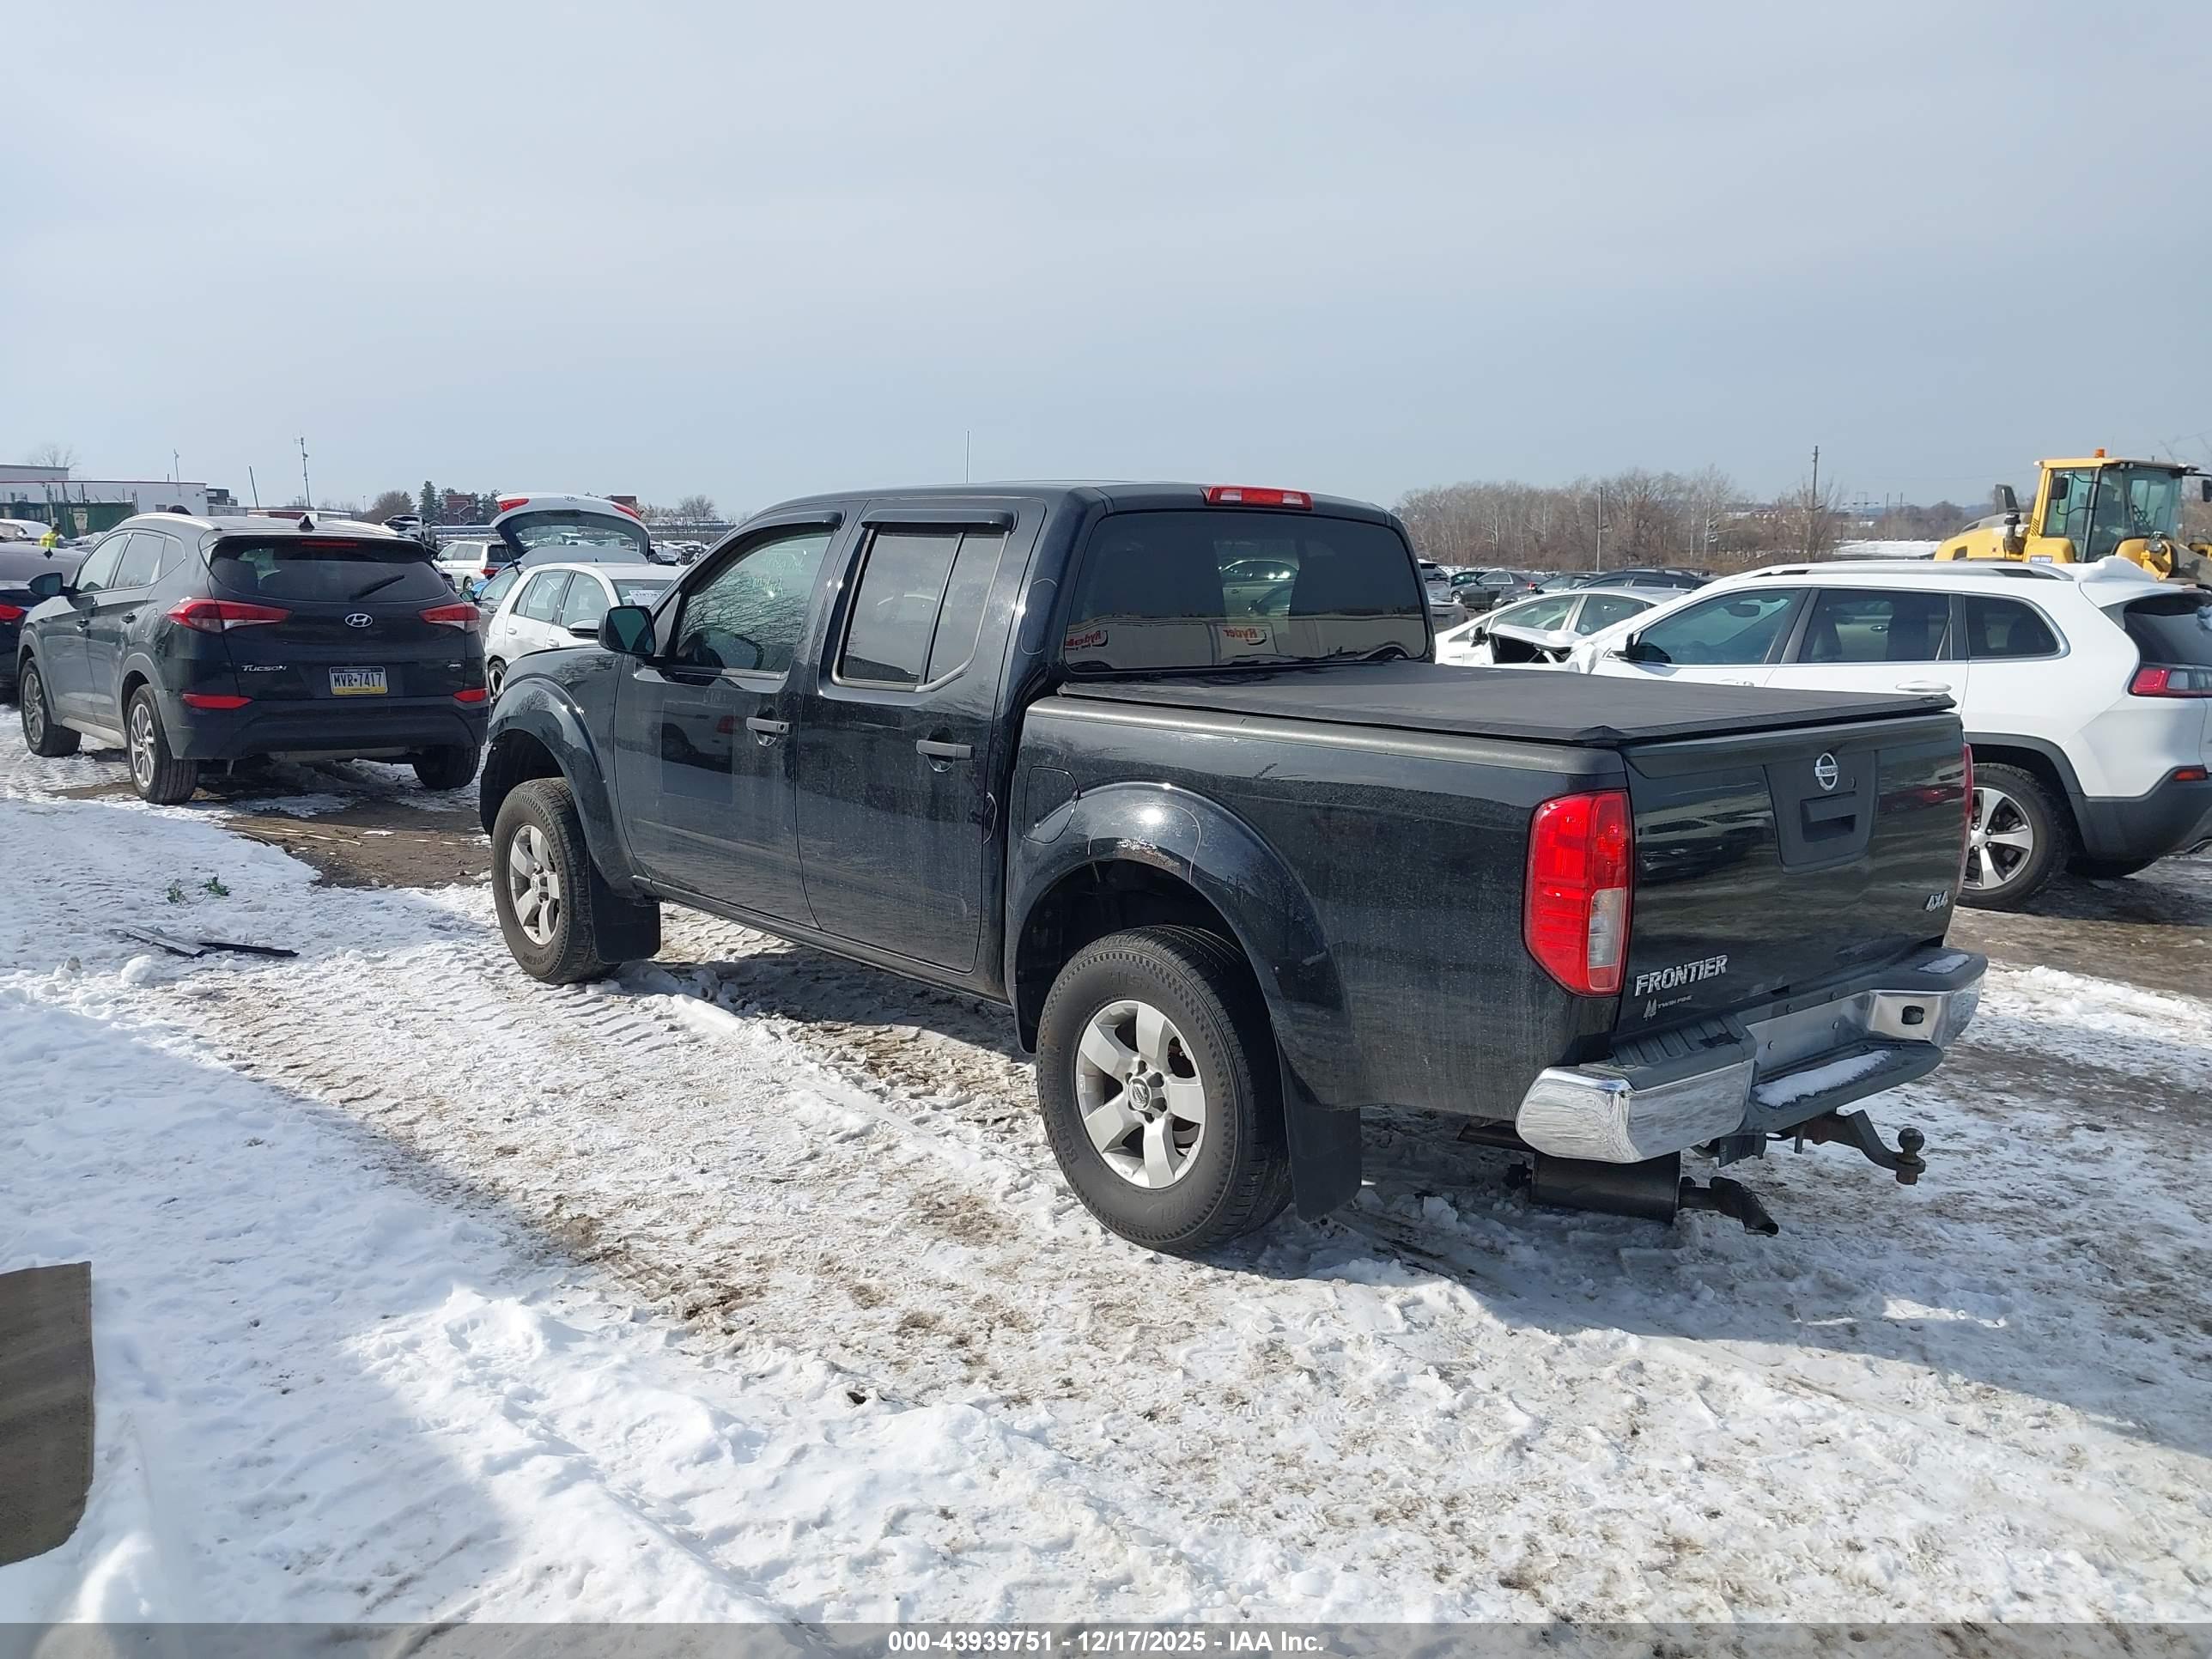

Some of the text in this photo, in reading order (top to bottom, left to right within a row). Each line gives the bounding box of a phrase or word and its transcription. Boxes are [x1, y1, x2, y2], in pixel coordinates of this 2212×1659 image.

[1925, 890, 1948, 913] 4X4
[1634, 954, 1729, 997] FRONTIER
[1657, 994, 1693, 1010] TWIN PINE
